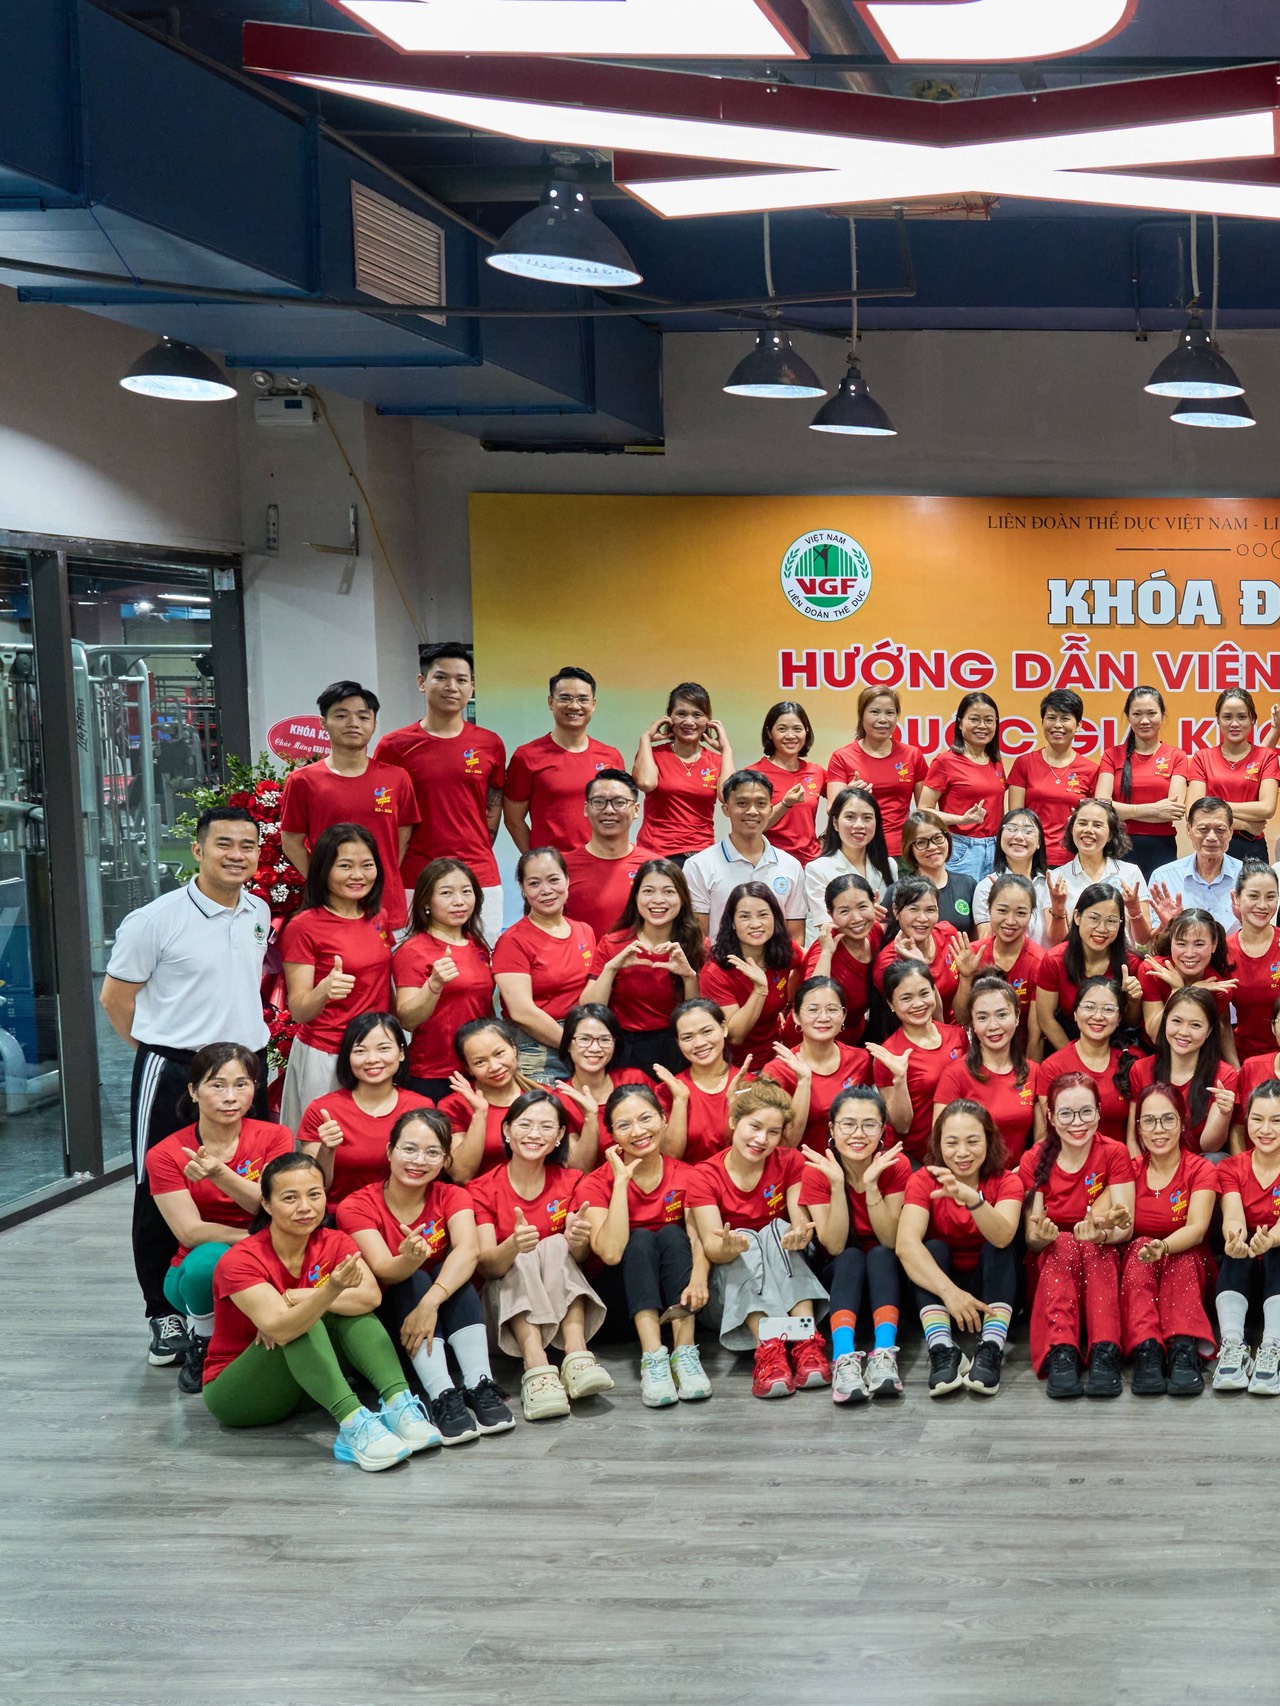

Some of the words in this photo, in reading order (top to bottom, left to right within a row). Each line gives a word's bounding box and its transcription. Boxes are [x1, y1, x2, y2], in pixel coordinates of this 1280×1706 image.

[987, 512, 1027, 530] LIÊN
[1031, 511, 1081, 530] ĐOÀN
[1085, 510, 1120, 530] THỂ
[1124, 516, 1161, 533] DỤC
[1166, 513, 1204, 533] VIỆT
[1208, 516, 1249, 530] NAM
[805, 533, 824, 544] VIỆT
[827, 533, 846, 545] NAM
[795, 578, 858, 595] VGF
[851, 590, 866, 607] DỤC
[1047, 568, 1222, 626] KHÓA
[779, 638, 997, 691] HƯỚNG
[1012, 632, 1137, 692] DẪN
[290, 724, 316, 738] KHÓA
